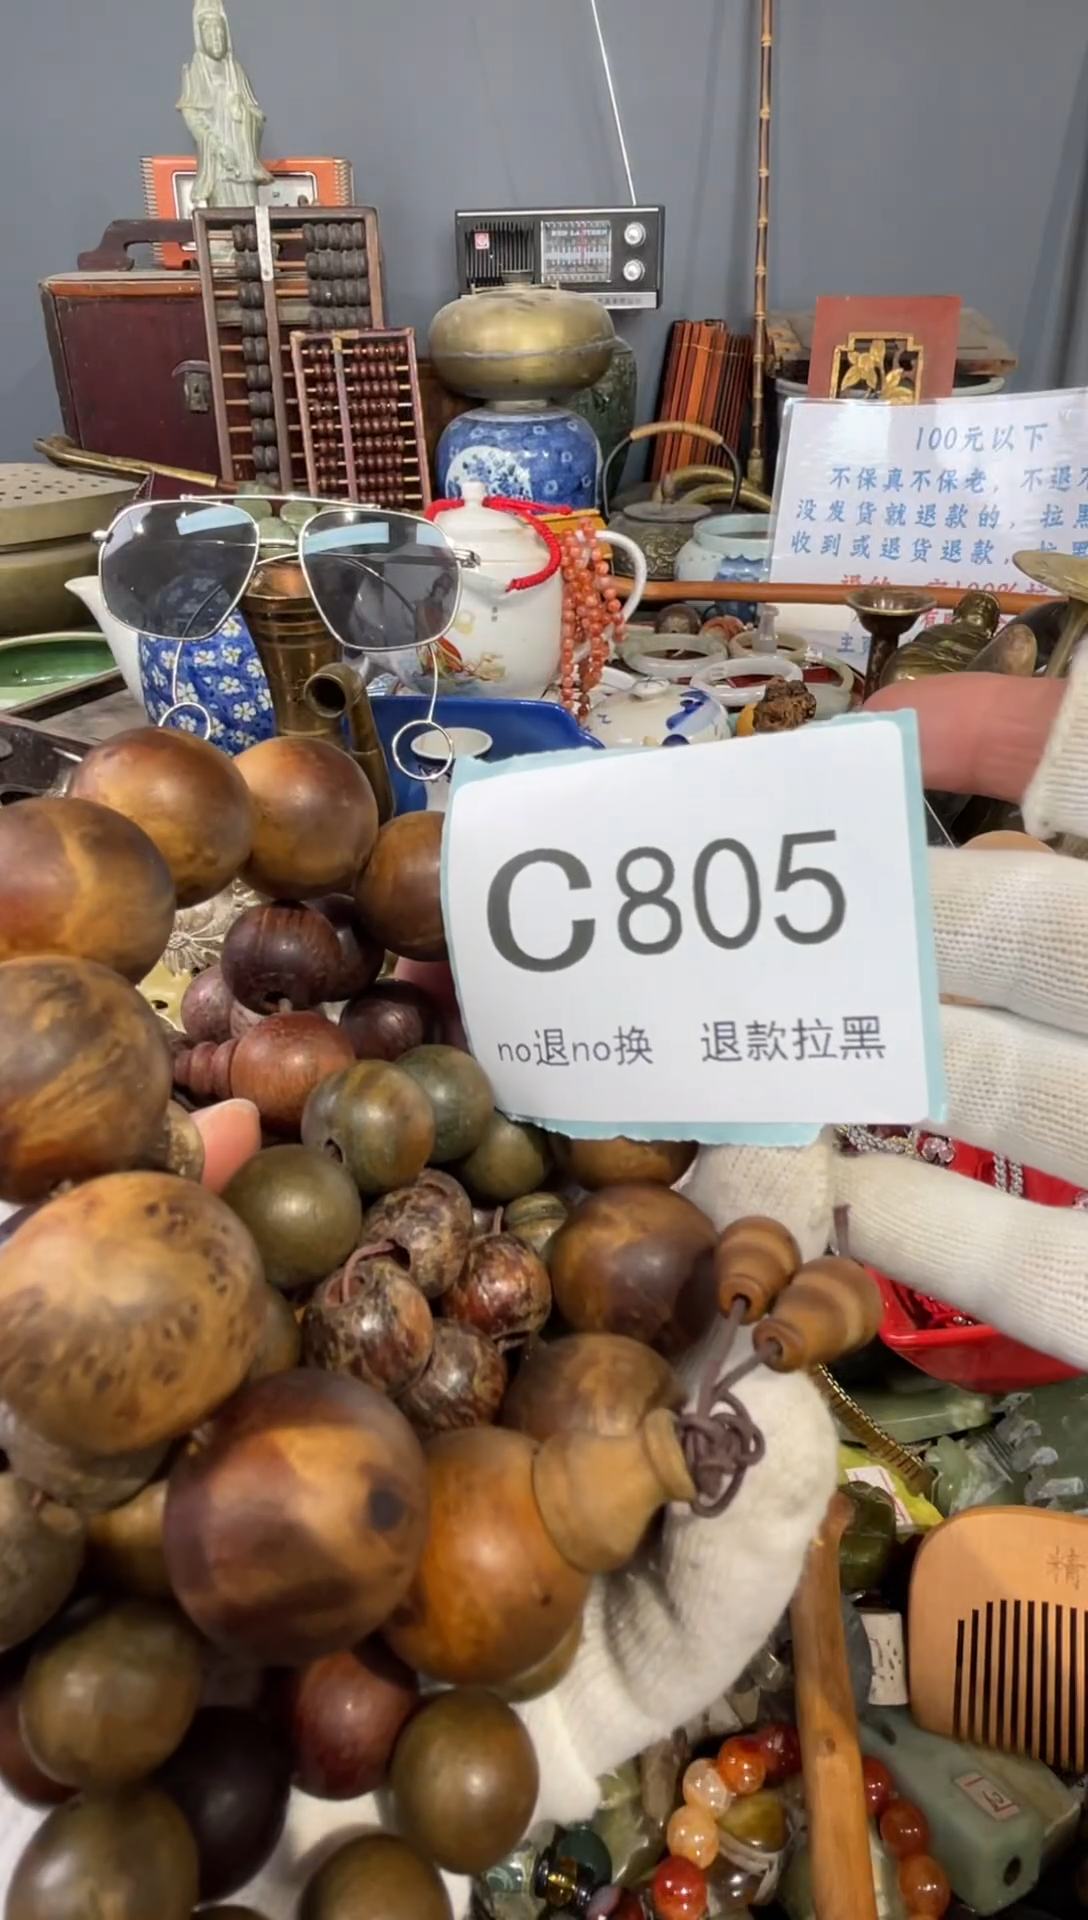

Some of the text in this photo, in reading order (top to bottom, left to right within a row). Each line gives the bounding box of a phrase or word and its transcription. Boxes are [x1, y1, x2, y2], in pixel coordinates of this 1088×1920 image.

[916, 423, 1049, 452] 100元以下
[487, 830, 846, 973] C805
[498, 1015, 886, 1068] no退no换 退款拉黑
